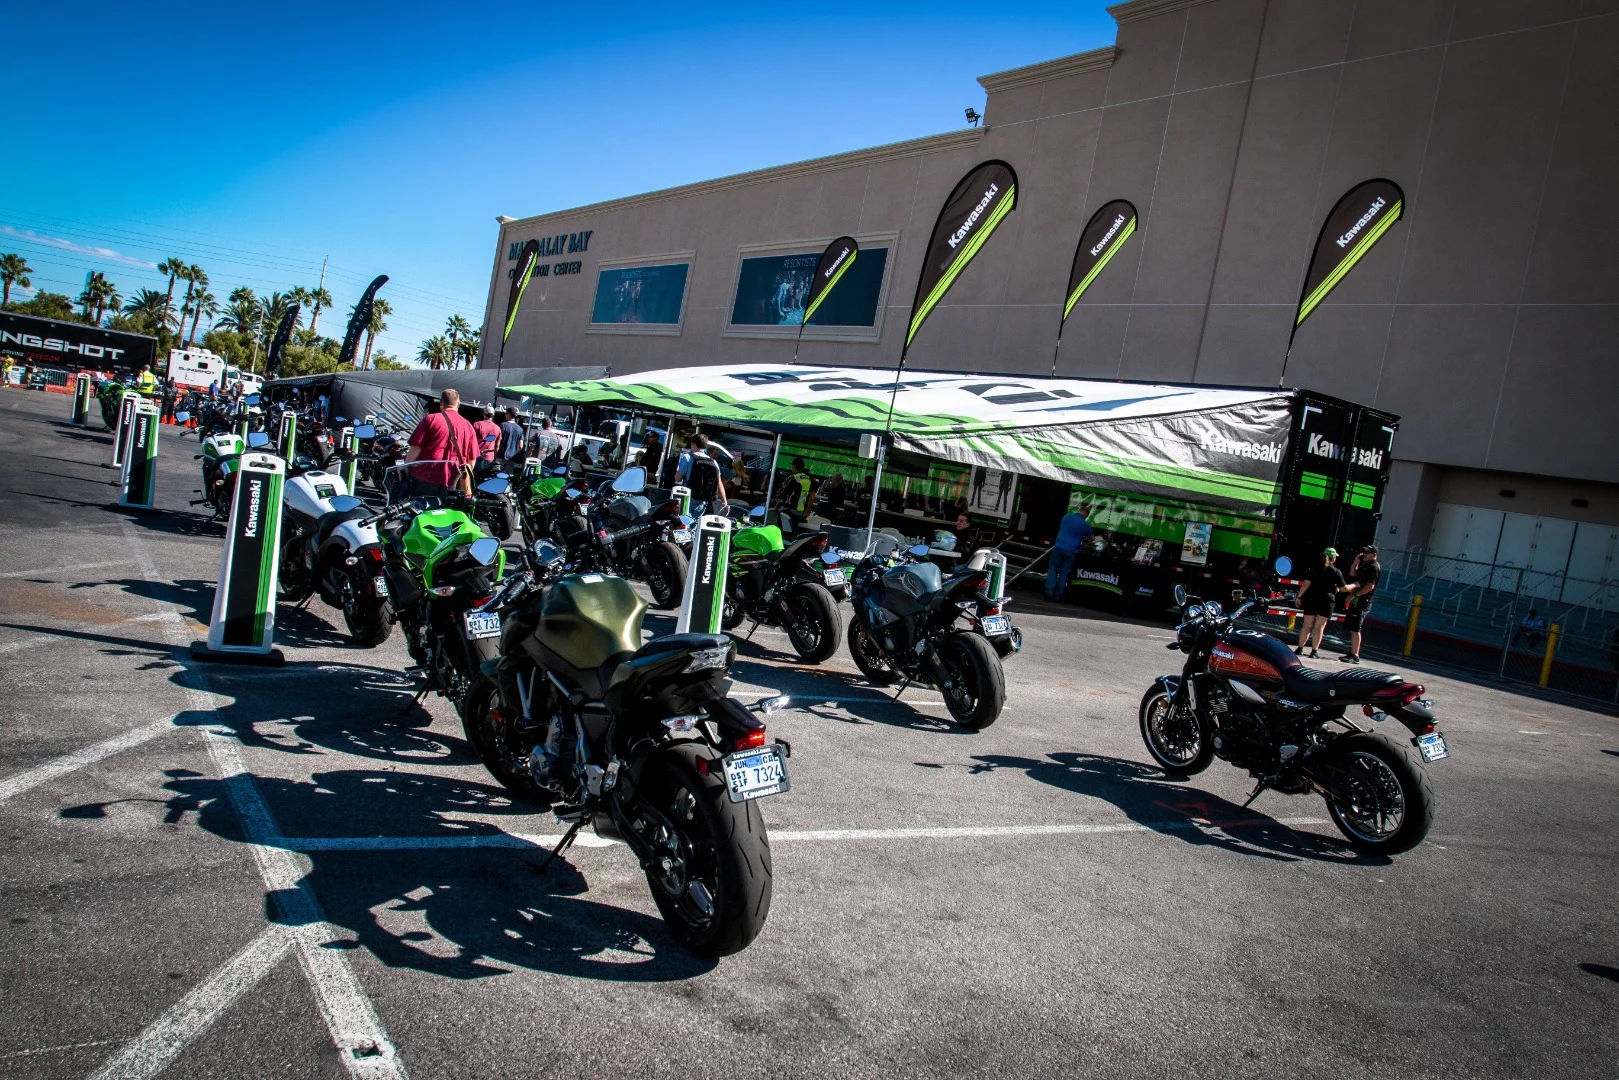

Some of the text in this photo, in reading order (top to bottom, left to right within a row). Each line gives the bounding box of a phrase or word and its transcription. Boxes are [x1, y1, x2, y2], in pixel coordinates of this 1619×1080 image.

[948, 182, 999, 248] Kawasaki
[1336, 196, 1386, 248] Kawasaki
[508, 230, 594, 261] MAALAY BAY
[1090, 213, 1126, 257] Kawasaki
[553, 261, 582, 276] CENTER
[824, 246, 850, 278] Kawasaki
[123, 401, 132, 425] Kawasaki
[137, 417, 147, 448] Kawasaki
[1200, 426, 1282, 464] Kawasaki
[1307, 431, 1384, 471] Kawasaki
[244, 479, 262, 538] Kawasaki
[701, 535, 716, 585] Kawasaki
[828, 545, 866, 561] Kawas
[1076, 567, 1120, 586] Kawasaki
[476, 631, 501, 639] Kawasak
[732, 747, 771, 759] kawasaki.com
[733, 760, 747, 770] JUN
[730, 770, 746, 781] DST
[753, 764, 782, 784] 7324
[742, 784, 781, 800] Kawasaki
